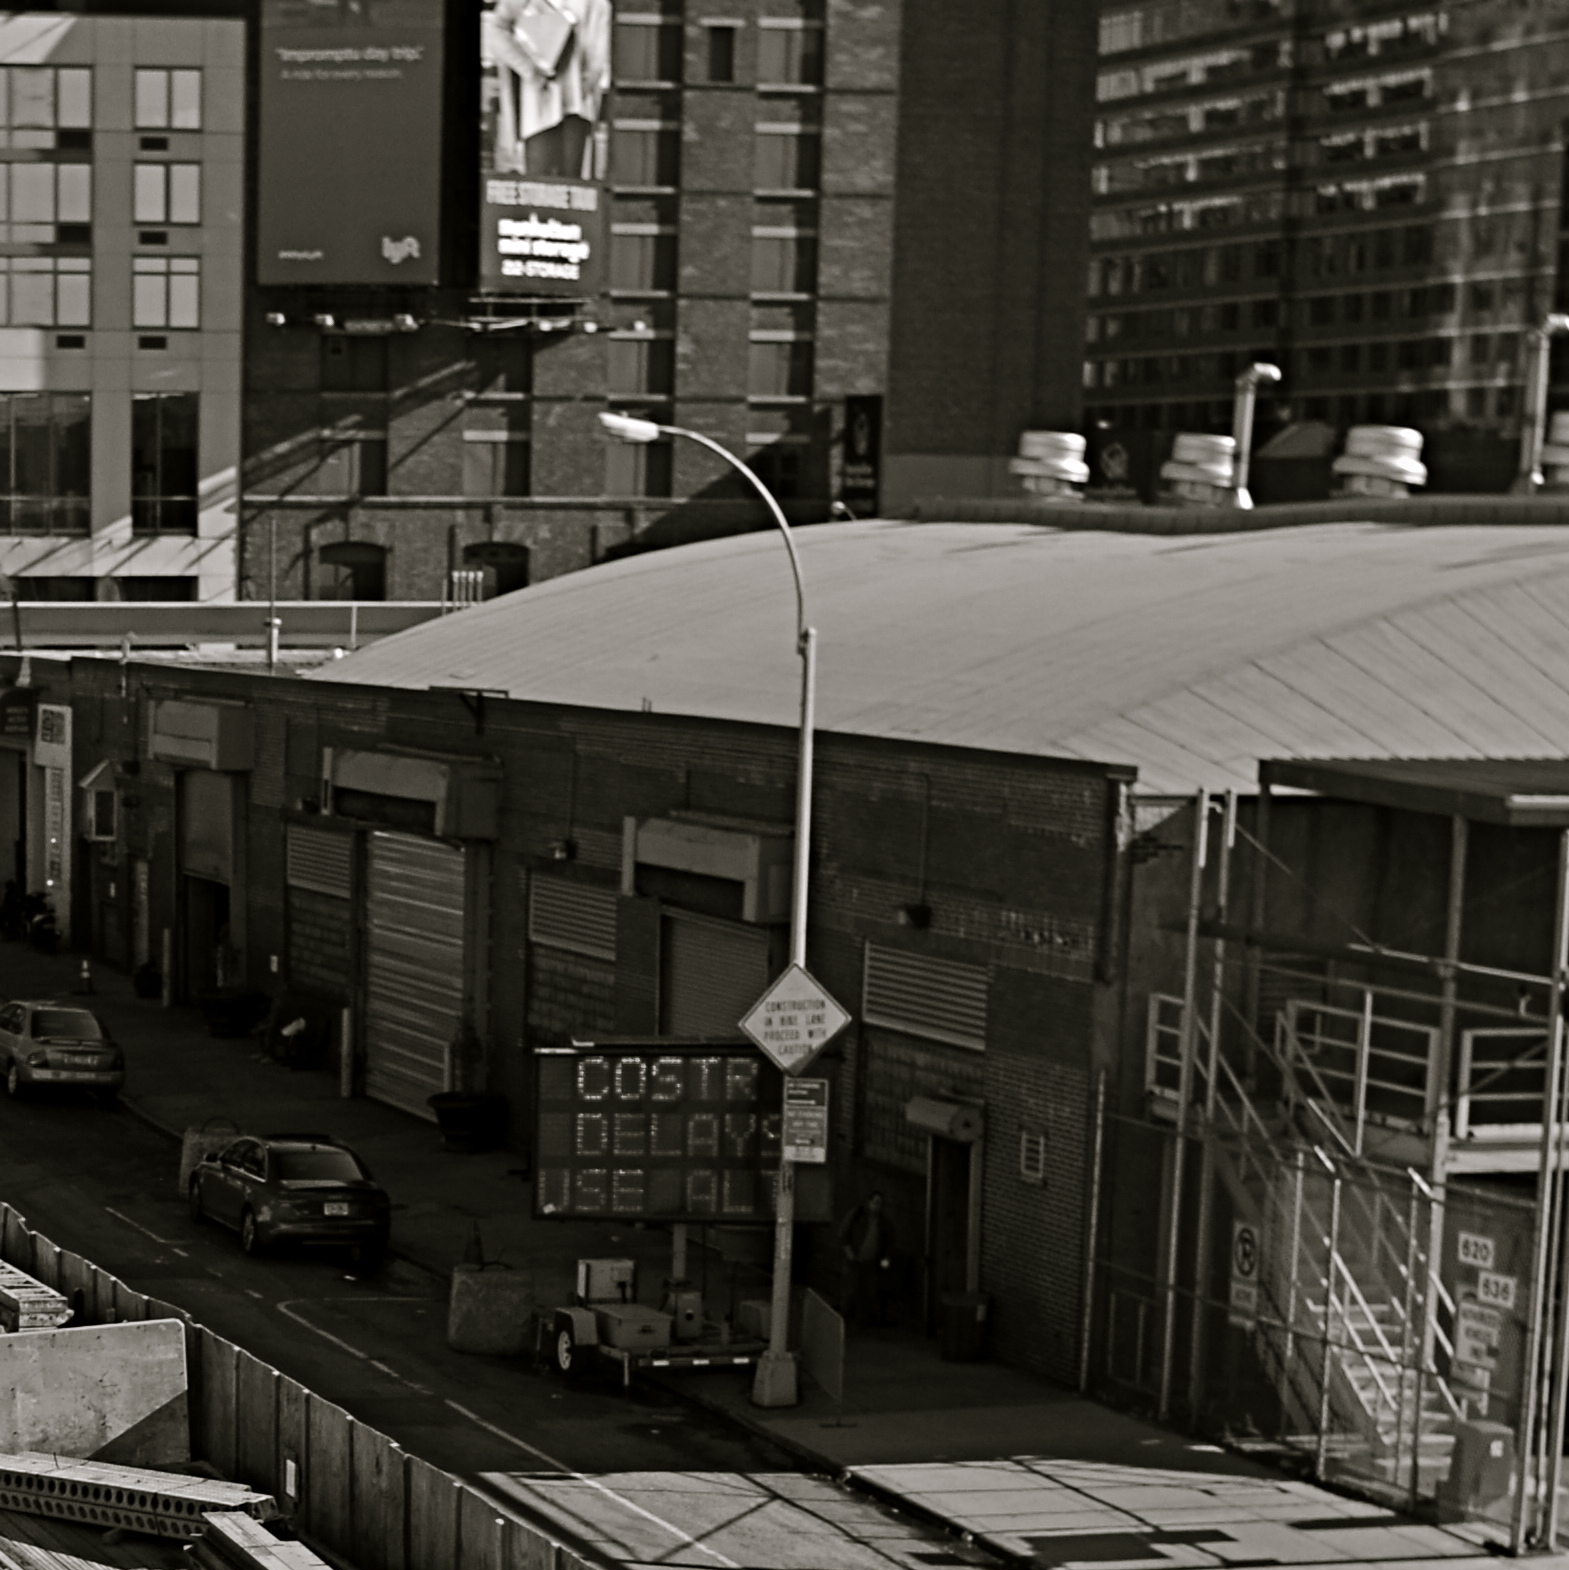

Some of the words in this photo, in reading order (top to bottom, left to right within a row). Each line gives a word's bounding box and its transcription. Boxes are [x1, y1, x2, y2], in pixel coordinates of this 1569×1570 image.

[765, 998, 827, 1014] CONSTRUCTION
[764, 1015, 774, 1028] IN
[779, 1014, 799, 1028] BIKE
[805, 1013, 827, 1026] LANE
[763, 1029, 801, 1042] PROCEED
[807, 1028, 828, 1041] WITH
[577, 1055, 759, 1101] COSTR
[538, 1168, 645, 1213] USE
[1461, 1239, 1489, 1263] 620
